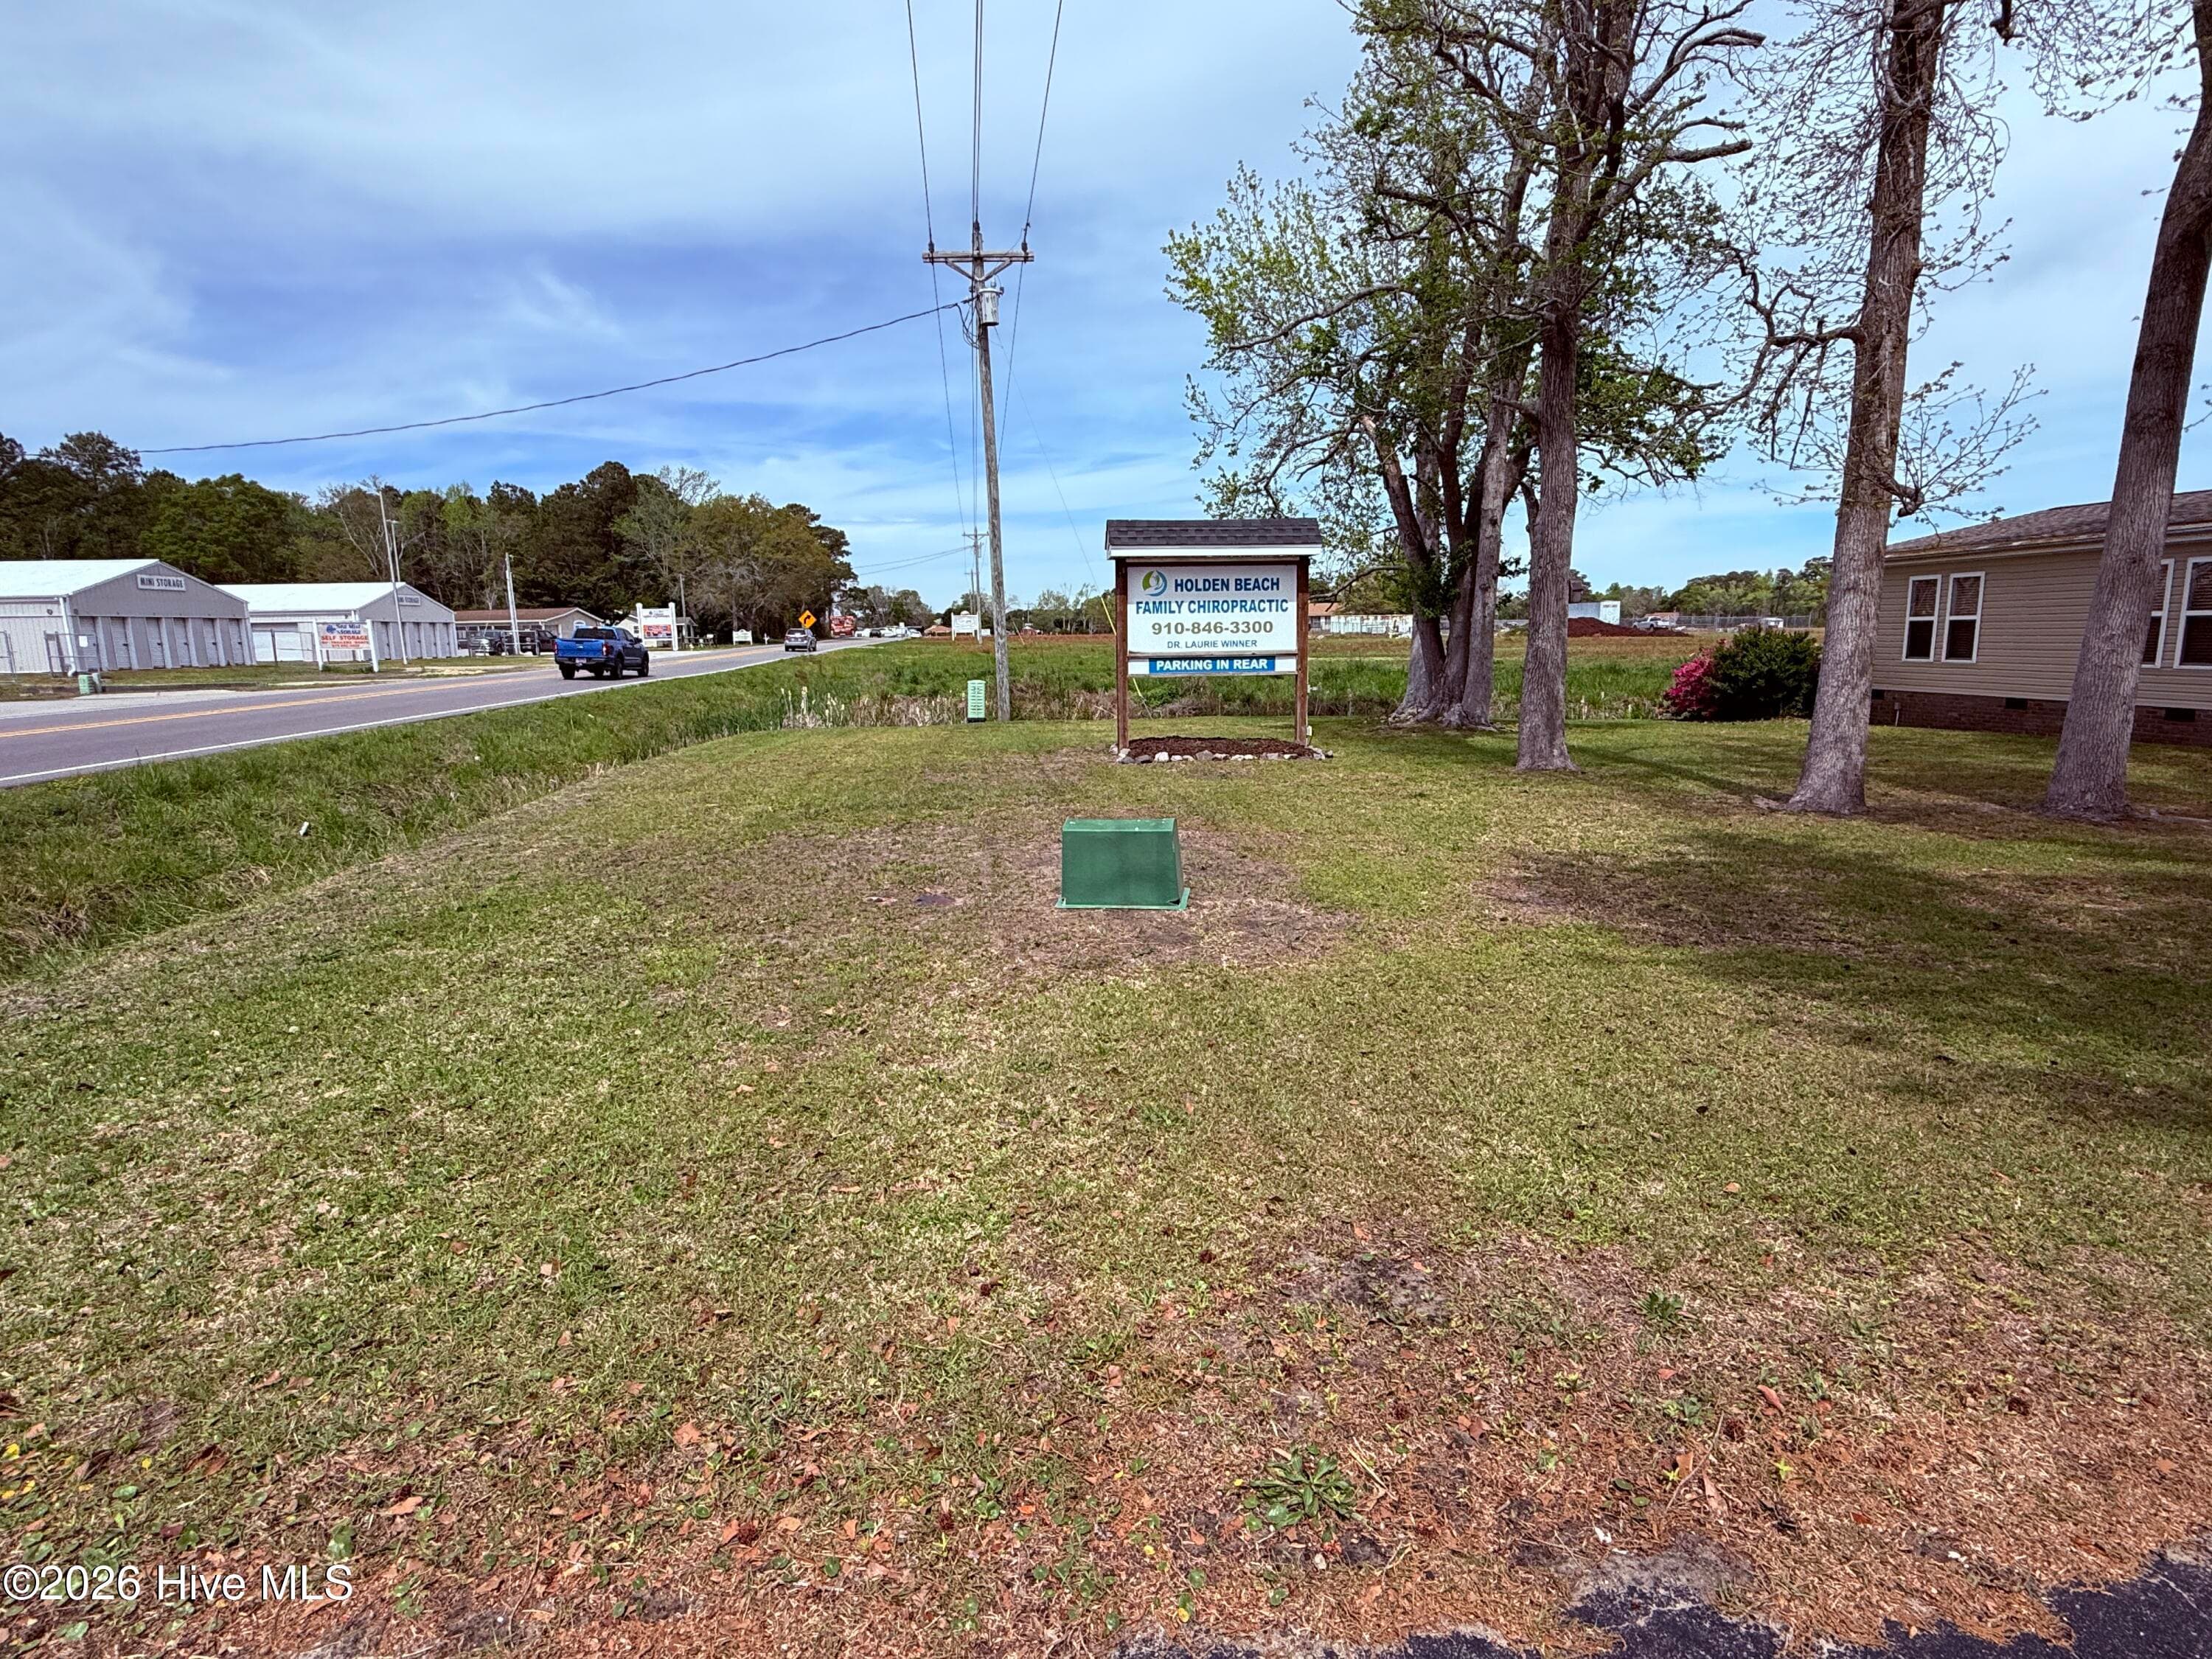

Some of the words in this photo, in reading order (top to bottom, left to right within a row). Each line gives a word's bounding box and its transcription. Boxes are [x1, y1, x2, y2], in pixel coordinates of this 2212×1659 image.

[140, 577, 154, 586] MINI
[156, 578, 184, 588] STORAGE
[1175, 578, 1229, 592] HOLDEN
[1234, 577, 1280, 591] BEACH
[1135, 600, 1184, 614] FAMILY
[1188, 599, 1289, 613] CHIROPRACTIC
[1152, 621, 1273, 635] 910-846-3300
[1167, 641, 1182, 649] DR.
[1185, 640, 1219, 649] LAURIE
[1156, 659, 1213, 671] PARKING
[1217, 658, 1229, 669] IN
[1234, 658, 1268, 669] REAR
